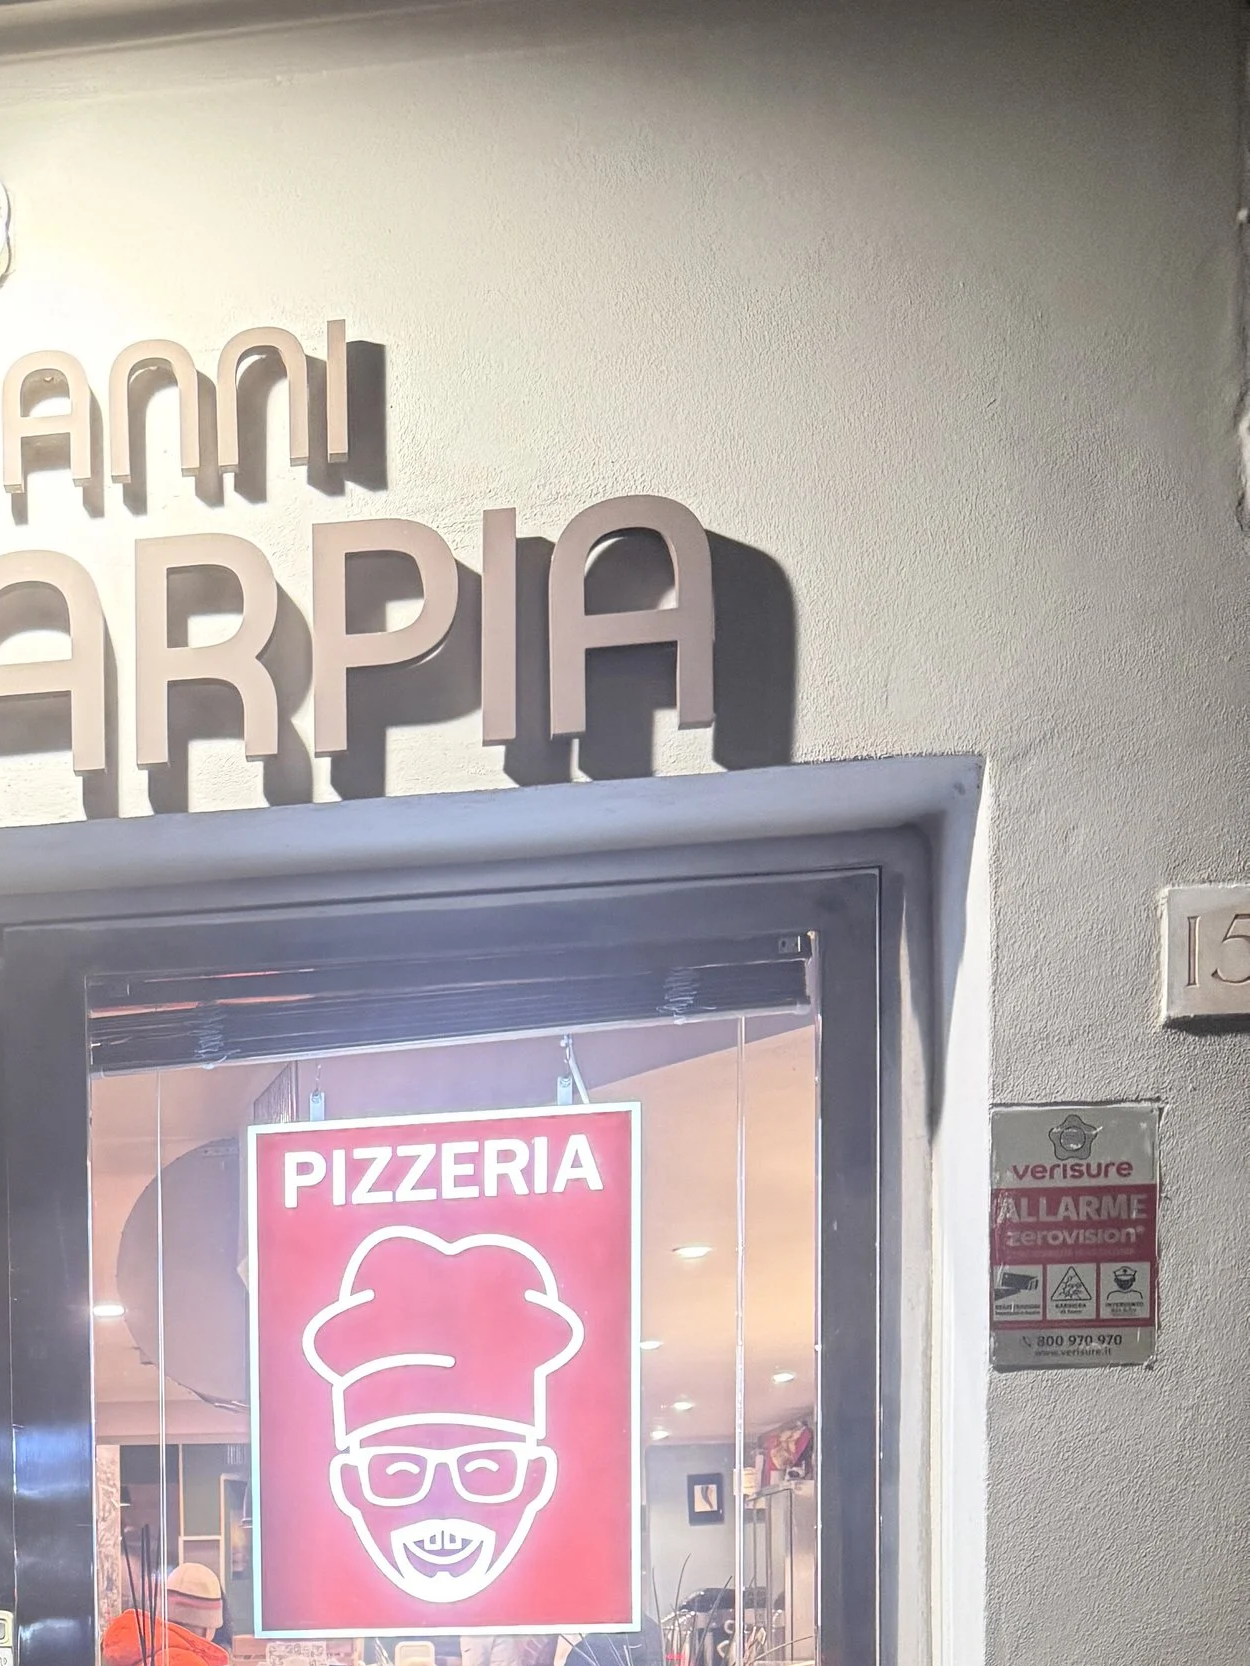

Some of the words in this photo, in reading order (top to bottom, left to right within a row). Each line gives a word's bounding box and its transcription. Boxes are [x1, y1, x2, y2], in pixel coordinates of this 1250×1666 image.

[283, 1133, 604, 1208] PIZZERIA
[1012, 1160, 1134, 1181] verisure
[999, 1194, 1147, 1224] ALLARME
[1037, 1335, 1064, 1348] 800
[1068, 1335, 1093, 1347] 970
[1098, 1334, 1123, 1346] 970
